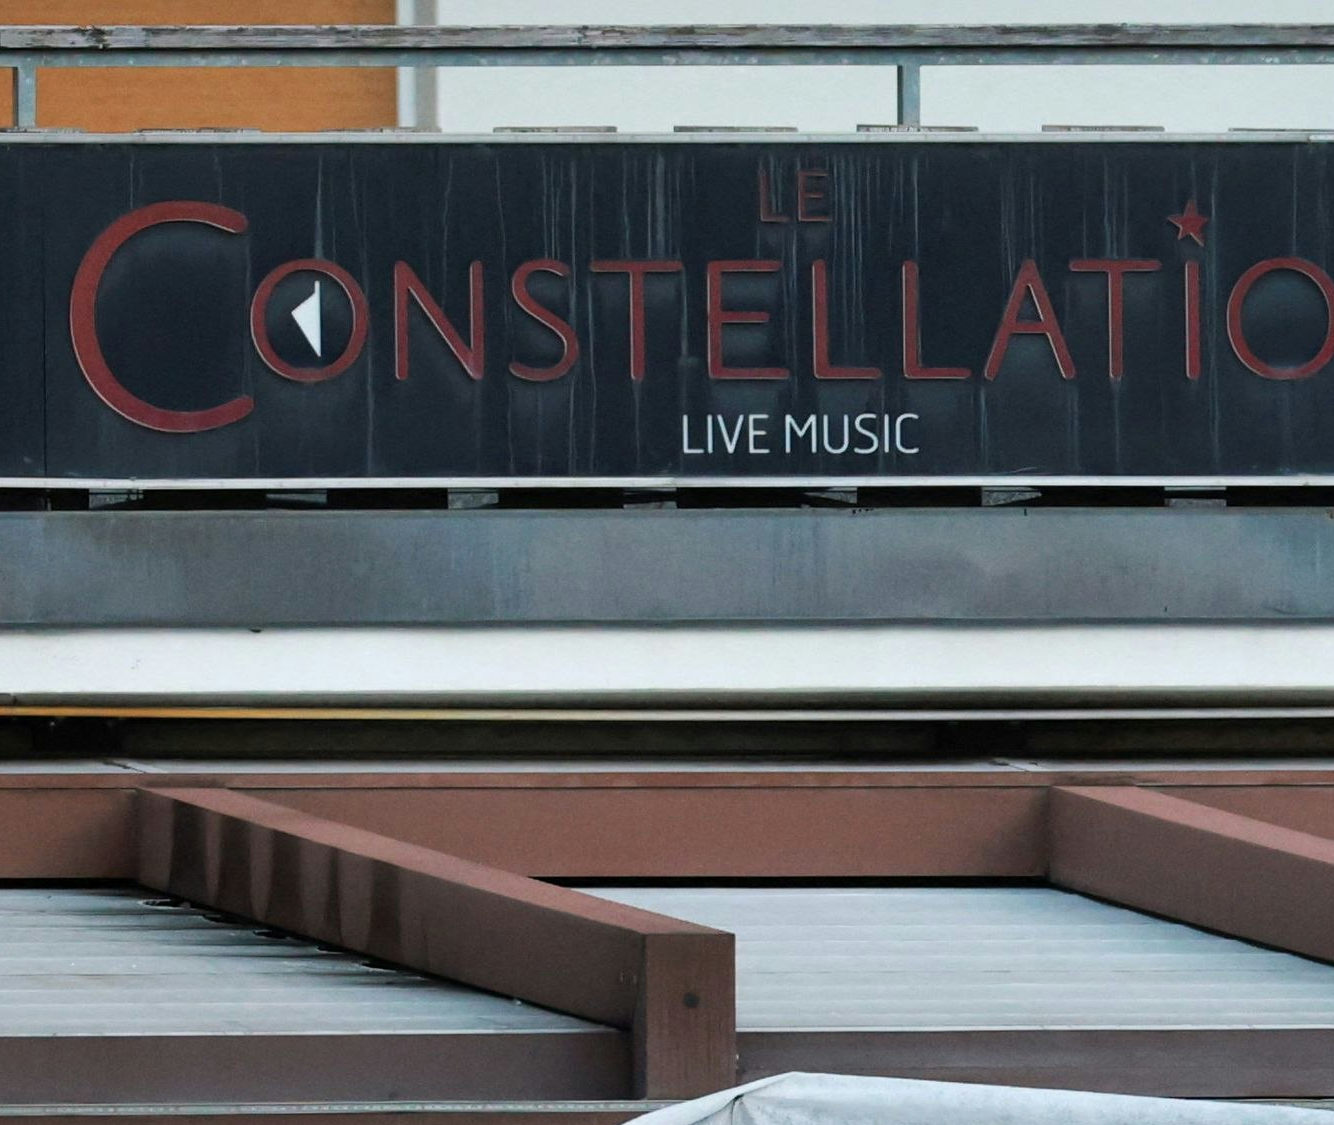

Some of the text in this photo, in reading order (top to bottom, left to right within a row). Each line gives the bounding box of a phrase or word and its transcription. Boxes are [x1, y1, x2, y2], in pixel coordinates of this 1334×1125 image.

[758, 169, 834, 222] LE
[681, 412, 920, 455] LIVE MUSIC
